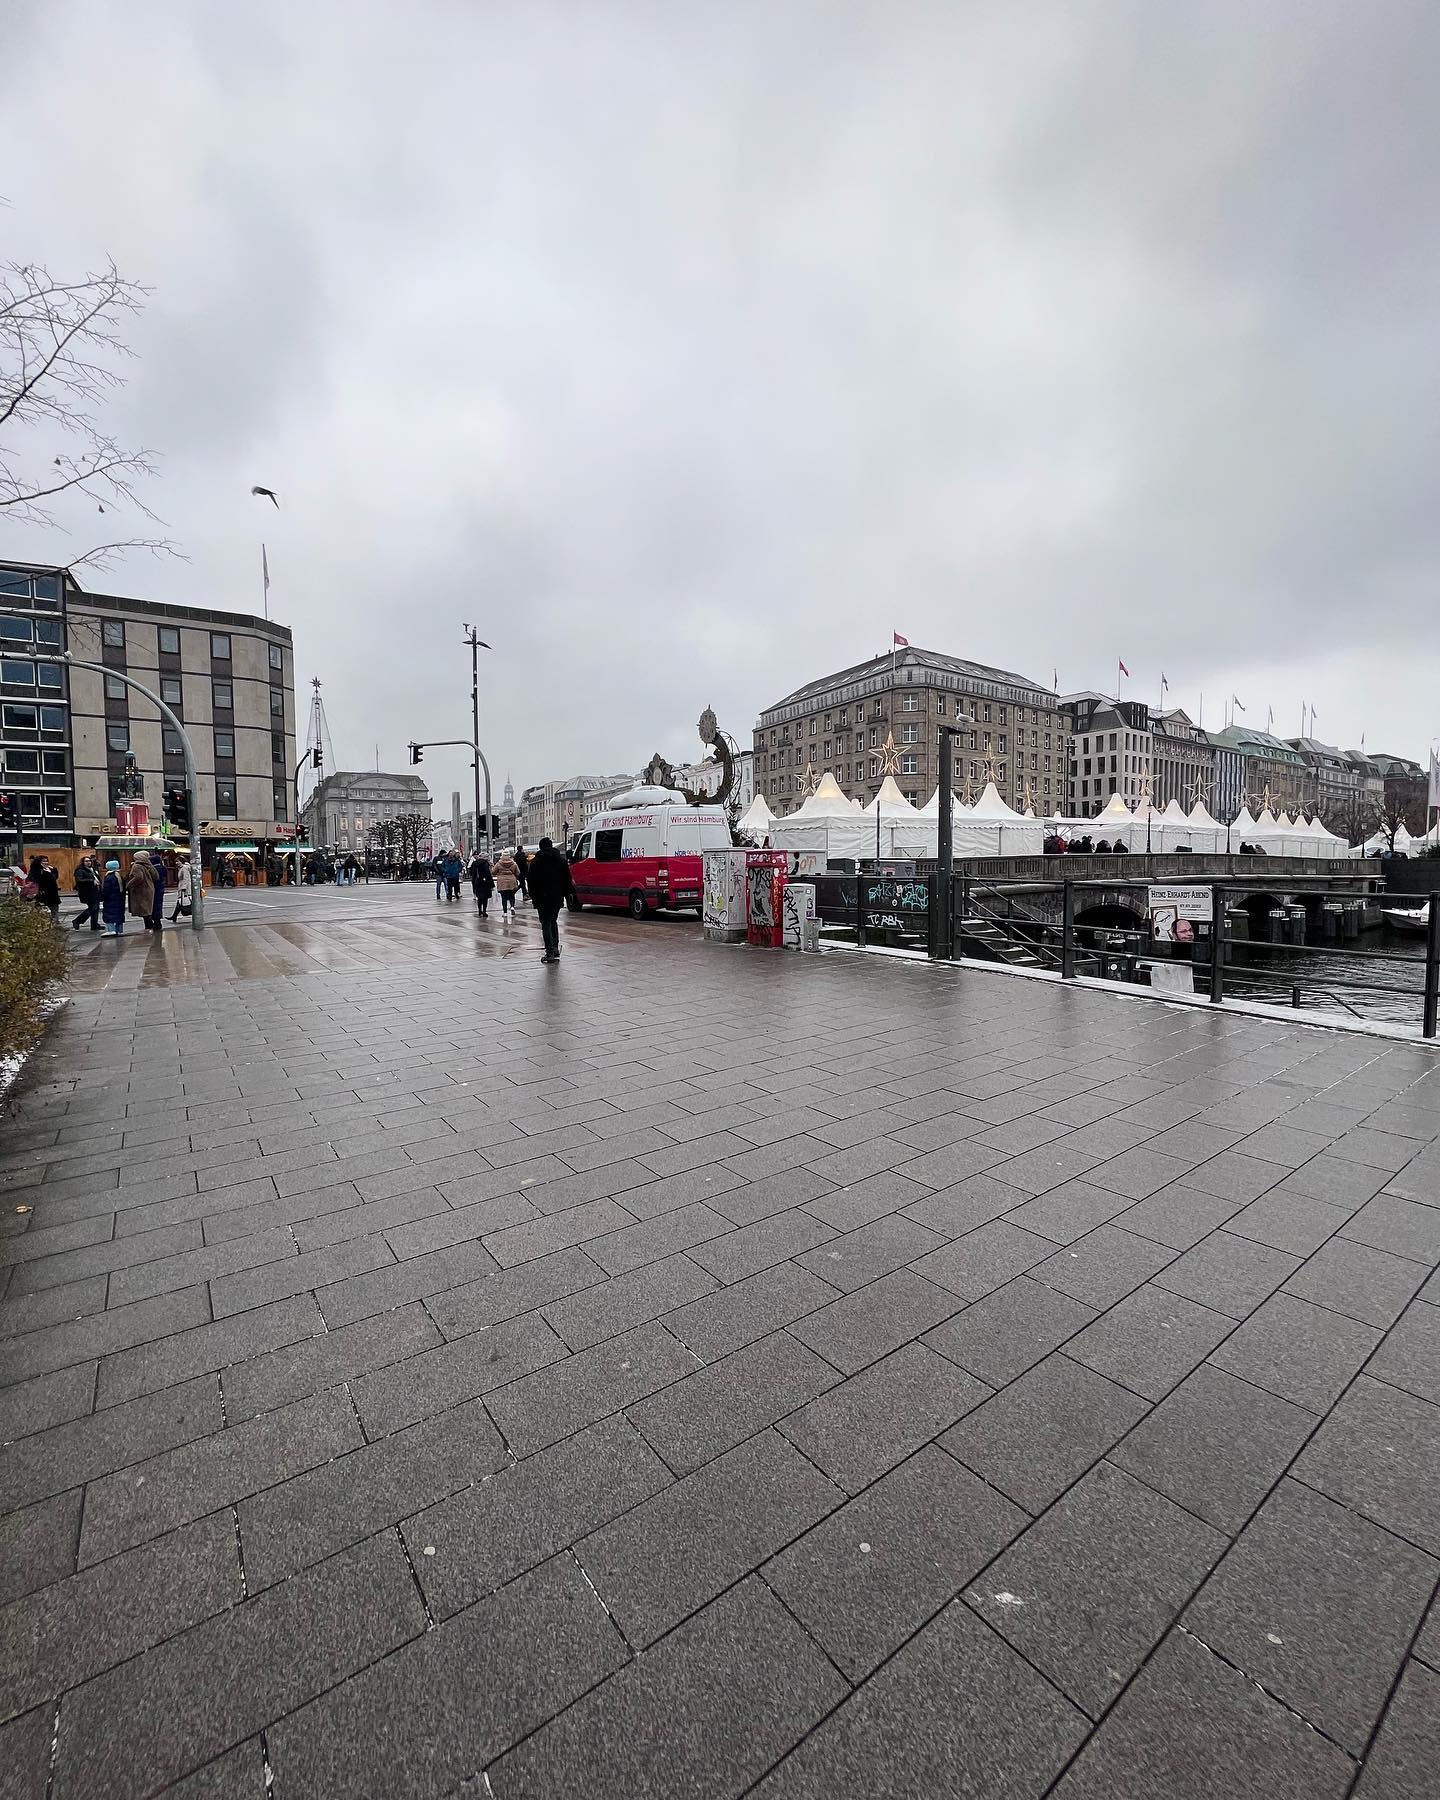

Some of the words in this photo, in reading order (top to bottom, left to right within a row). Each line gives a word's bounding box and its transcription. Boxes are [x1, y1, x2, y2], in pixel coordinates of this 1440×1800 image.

[602, 818, 611, 828] Wir
[611, 816, 624, 827] sind
[624, 815, 653, 826] Hamburg
[698, 816, 725, 825] Hamburg
[621, 848, 632, 858] NDR
